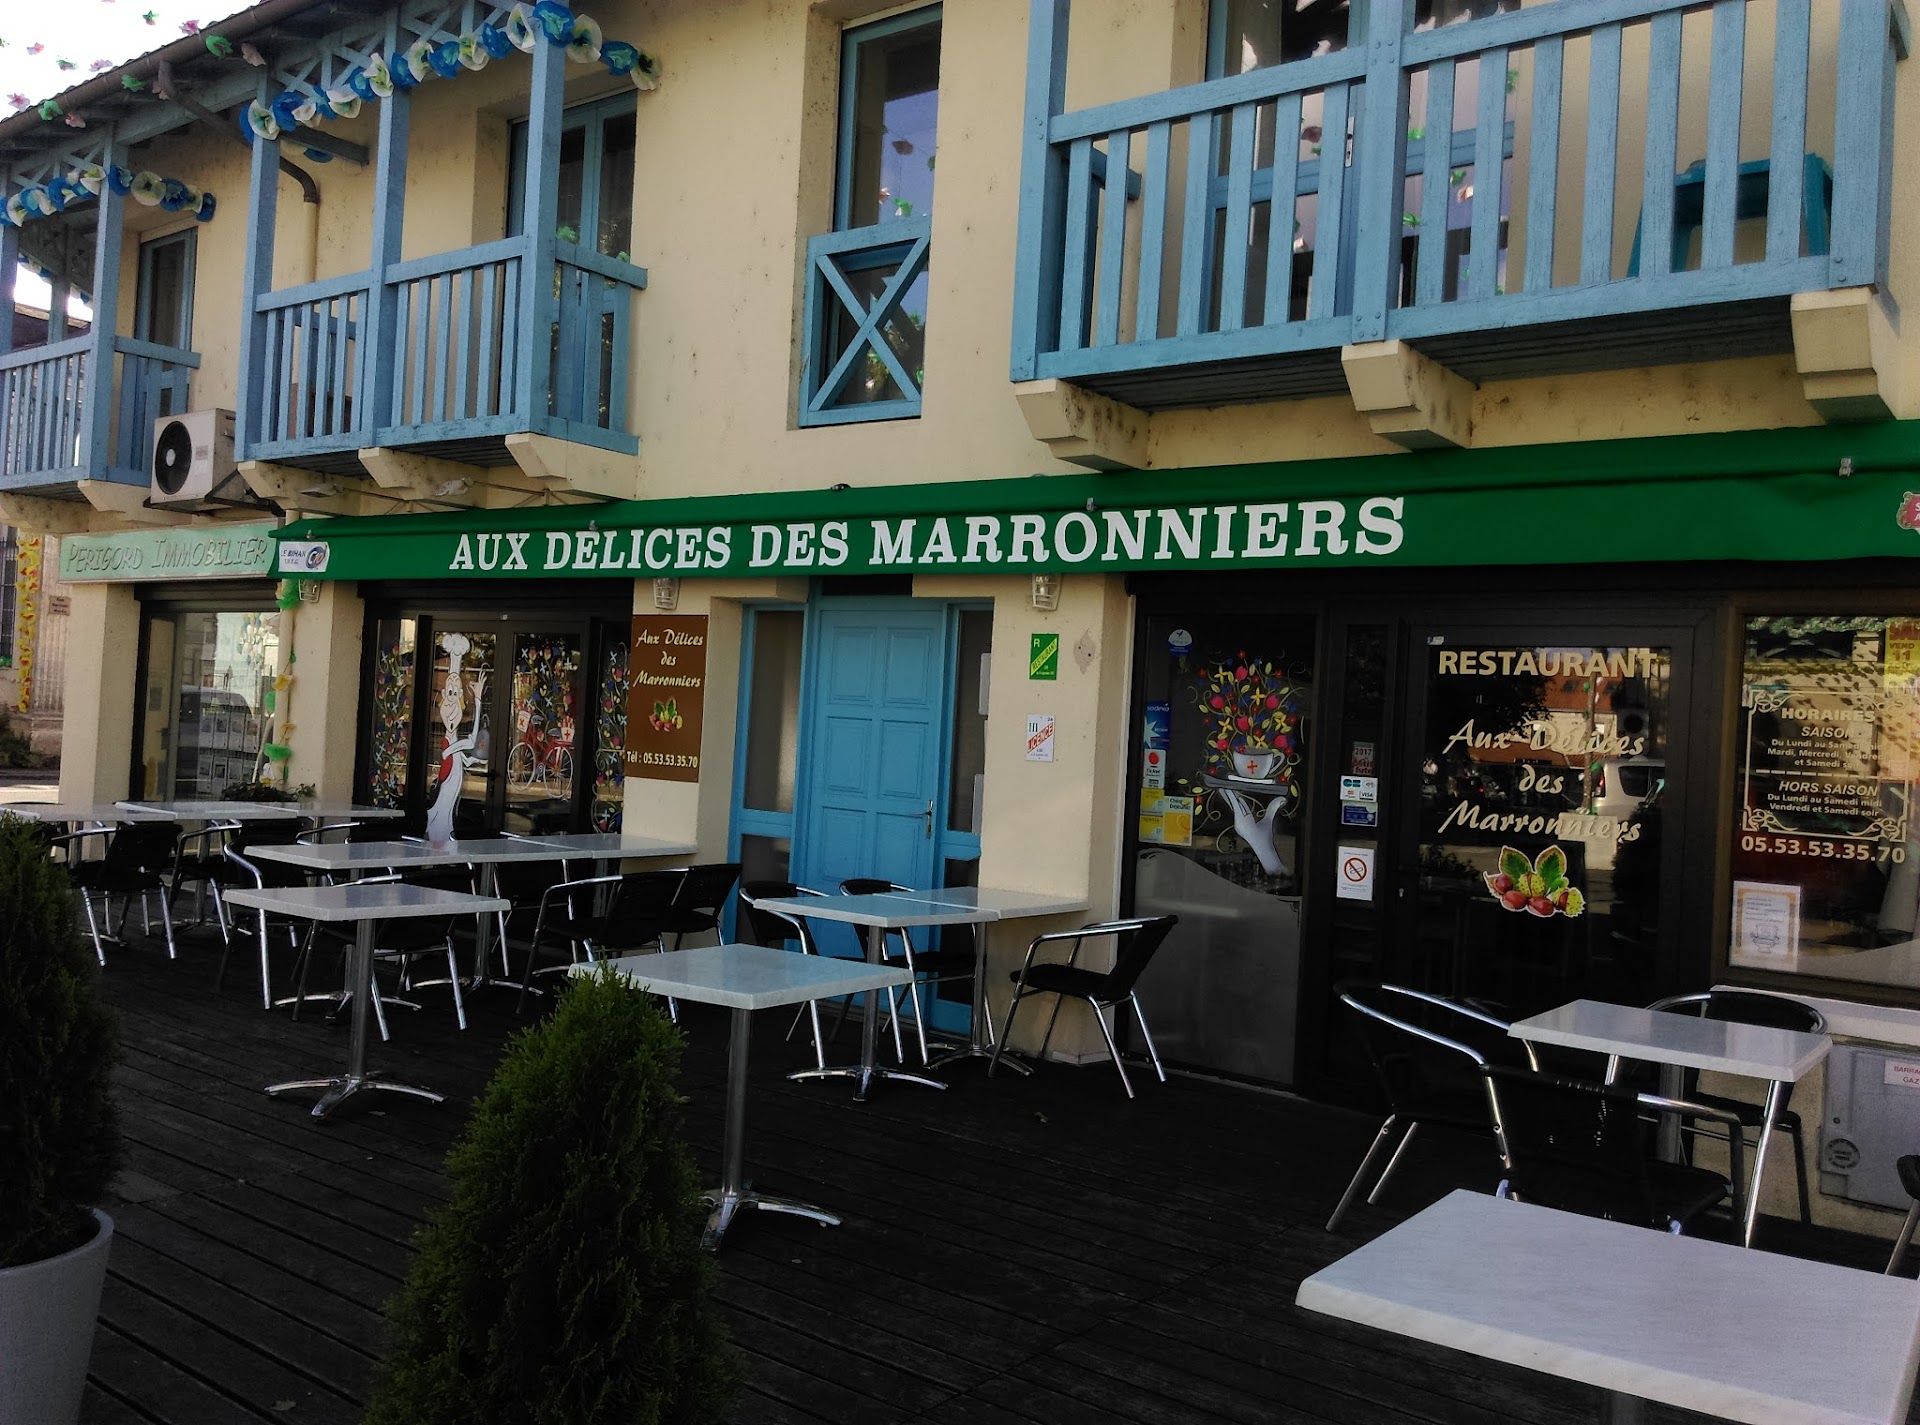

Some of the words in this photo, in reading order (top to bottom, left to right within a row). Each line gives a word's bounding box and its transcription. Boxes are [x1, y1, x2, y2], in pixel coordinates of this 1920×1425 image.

[448, 532, 530, 570] AUX
[748, 521, 850, 568] DES
[868, 496, 1405, 566] MARRONNIERS
[66, 544, 144, 573] PERIGORD
[151, 537, 268, 569] IMMOBILIER
[635, 629, 660, 648] Aux
[663, 628, 704, 647] Délices
[1033, 638, 1041, 648] R
[660, 650, 677, 666] des
[1032, 640, 1057, 671] RESTAURANT
[1438, 650, 1657, 678] RESTAURANT
[633, 669, 702, 688] Marronniers
[1781, 708, 1876, 723] HORAIRES
[1442, 718, 1511, 754] Aux
[1524, 719, 1645, 756] Délices
[1801, 727, 1854, 739] SAISON
[1355, 748, 1372, 756] 2017
[1772, 739, 1783, 747] Du
[1787, 739, 1812, 748] Lundi
[1828, 741, 1862, 750] Samedi
[626, 751, 638, 763] Tél
[643, 753, 698, 769] 05.53.53.35.70
[1767, 748, 1796, 757] Mardi,
[1799, 750, 1842, 759] Mercredi,
[1806, 760, 1840, 768] Samedi
[1518, 764, 1565, 794] des
[1779, 781, 1819, 793] HORS
[1823, 783, 1879, 797] SAISON
[1782, 794, 1808, 803] Lundi
[1824, 797, 1858, 806] Samedi
[1861, 798, 1882, 807] midi
[1770, 803, 1810, 812] Vendredi
[1812, 805, 1822, 813] et
[1824, 806, 1859, 815] Samedi
[1861, 808, 1879, 817] soir
[1438, 800, 1642, 842] Marronniers
[1741, 836, 1906, 864] 05.53.53.35.70
[1893, 1065, 1920, 1074] BARRA
[1903, 1077, 1919, 1085] GAZ
